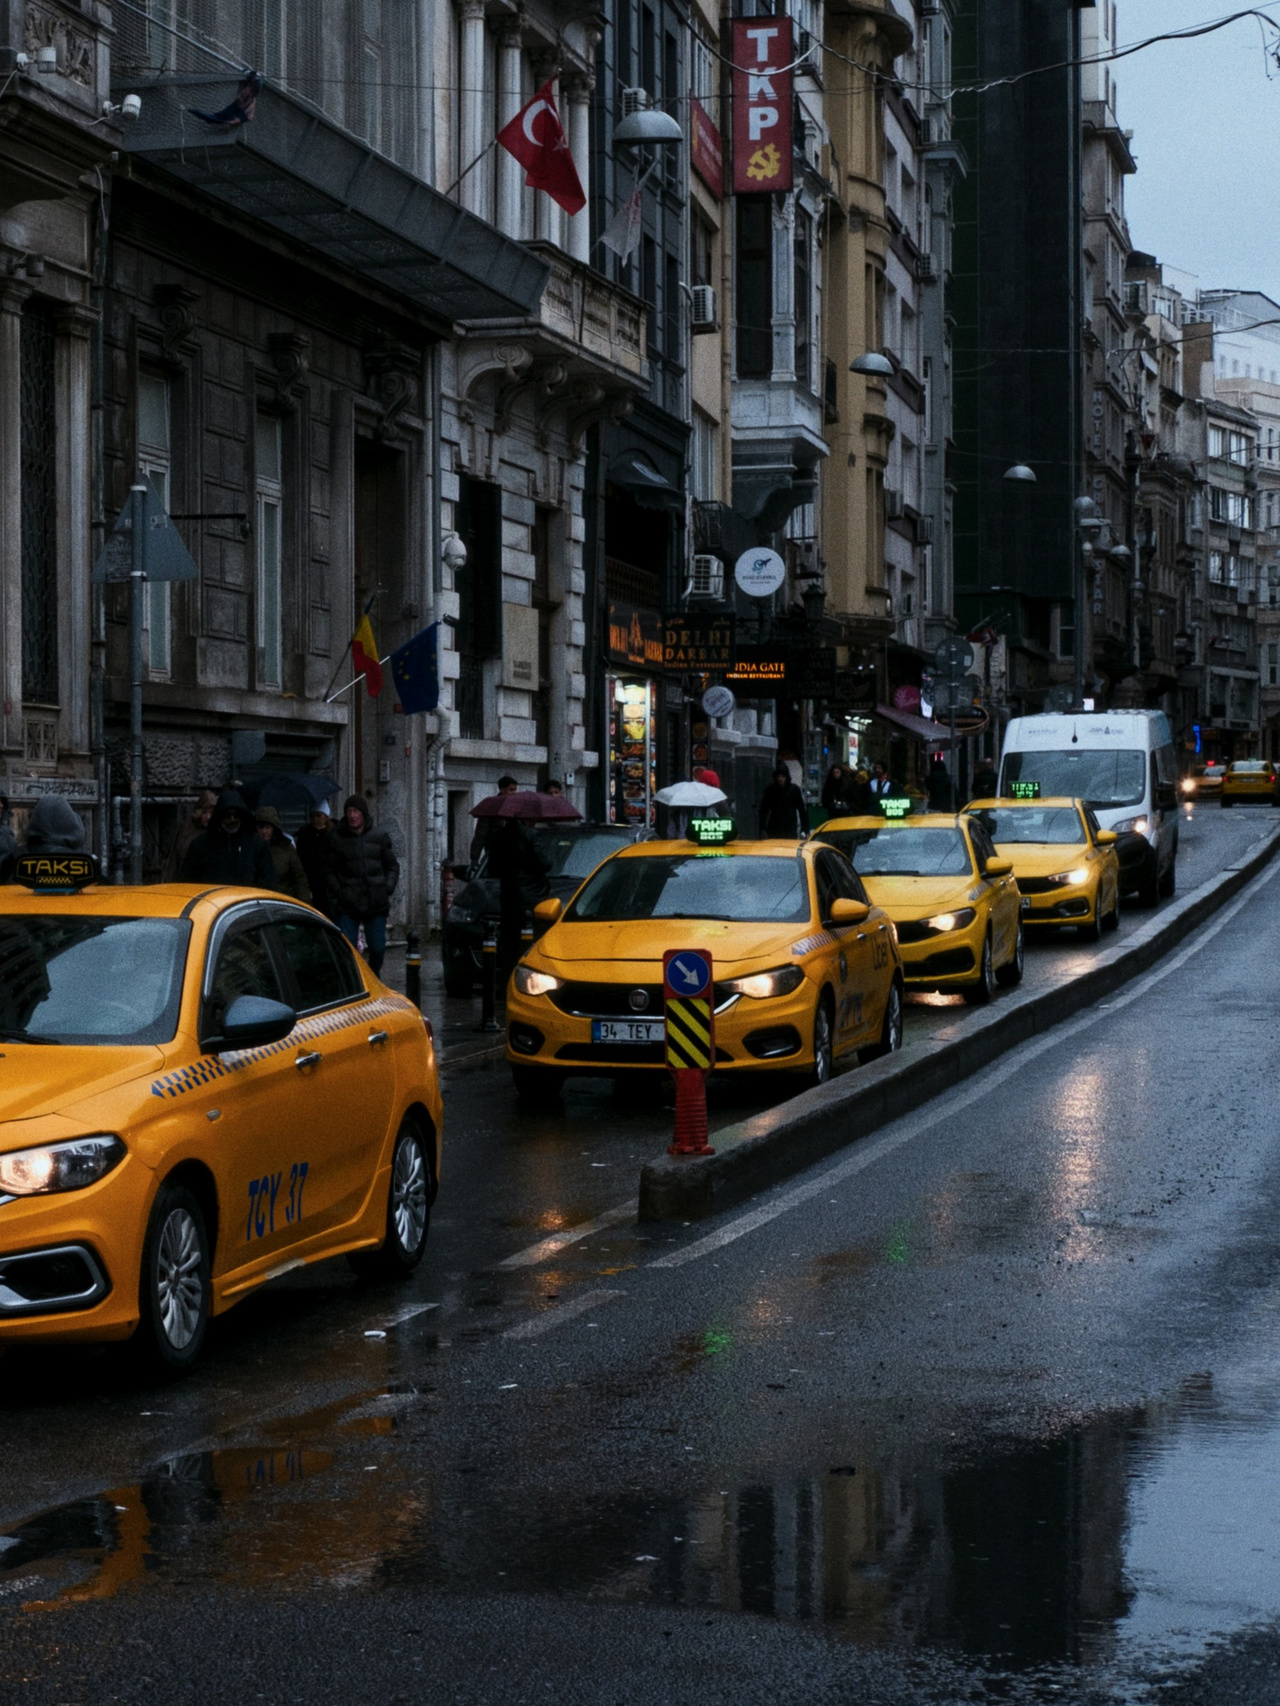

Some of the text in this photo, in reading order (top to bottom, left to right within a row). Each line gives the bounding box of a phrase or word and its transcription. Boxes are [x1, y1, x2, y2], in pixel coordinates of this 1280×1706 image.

[746, 28, 779, 141] TKP
[1093, 560, 1105, 615] STAR
[665, 629, 731, 646] DELHI
[665, 647, 731, 660] DARBAR
[664, 661, 688, 669] Indian
[759, 662, 785, 672] GATE
[601, 1023, 653, 1039] 34 TEY
[246, 1162, 308, 1241] TCY 37
